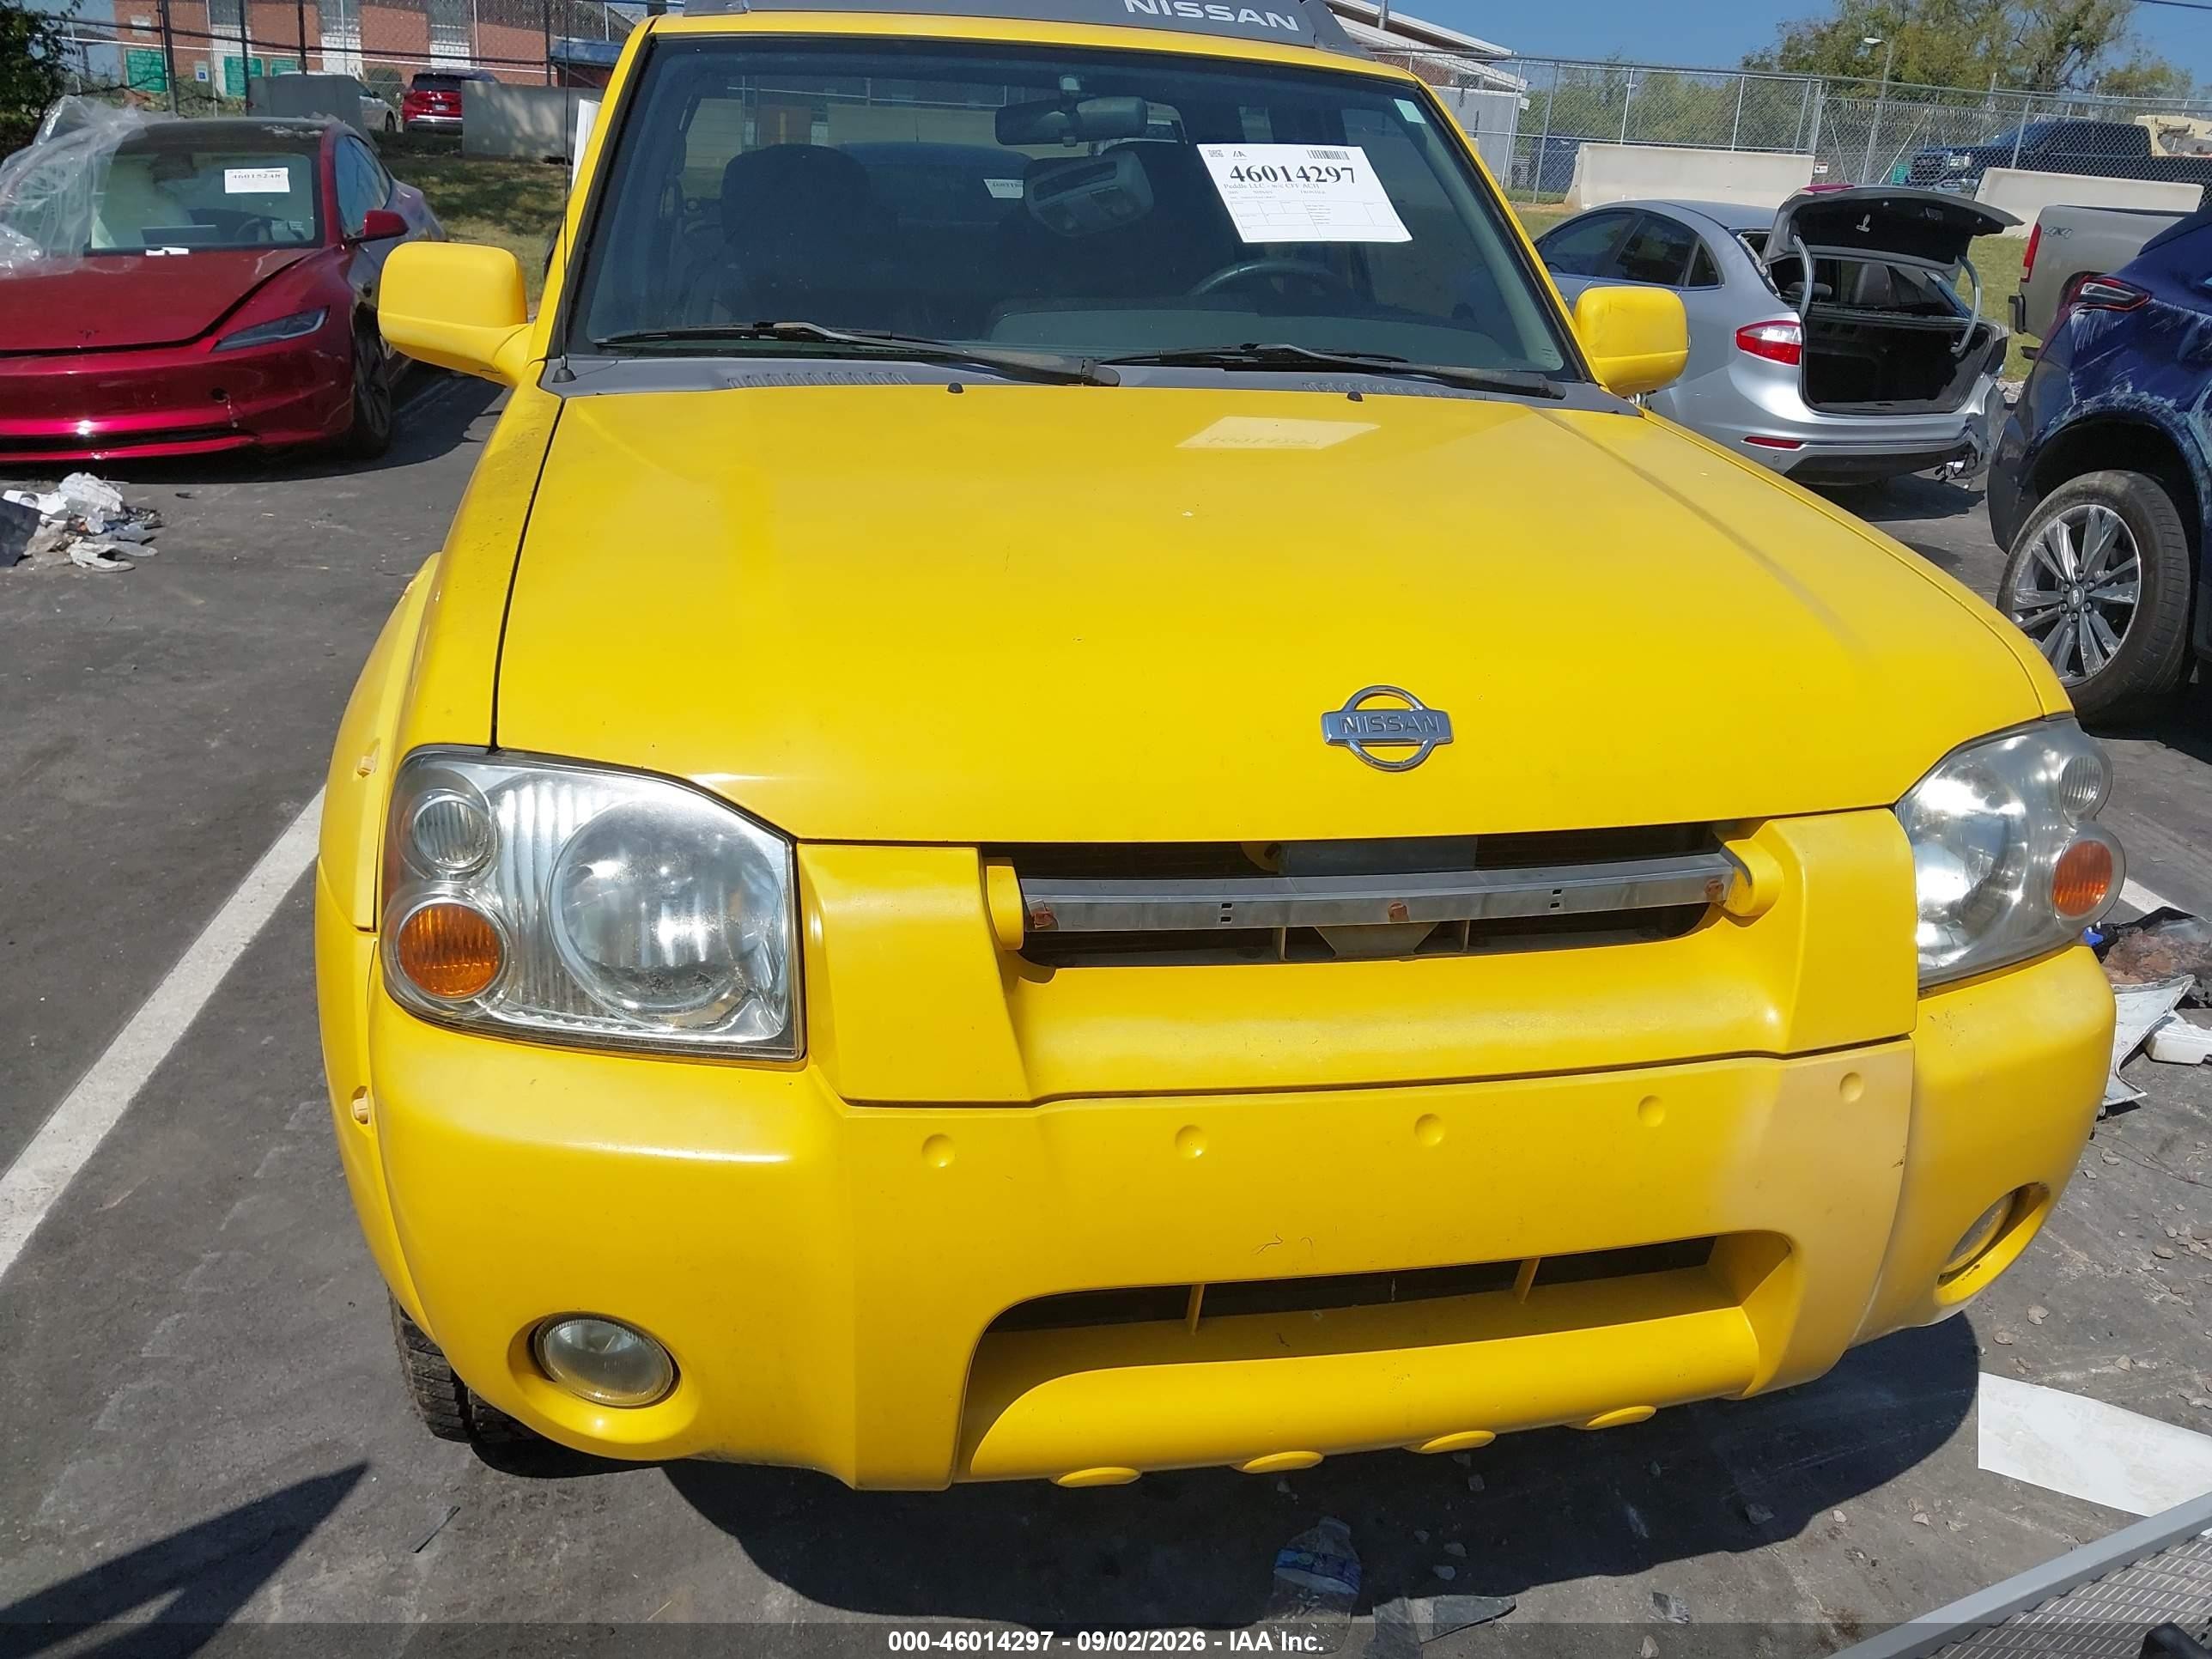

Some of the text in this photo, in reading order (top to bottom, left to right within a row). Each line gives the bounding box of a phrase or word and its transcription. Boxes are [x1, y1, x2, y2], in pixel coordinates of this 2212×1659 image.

[1124, 0, 1299, 31] NISSAN
[1230, 165, 1355, 184] 46014297
[1340, 714, 1441, 734] NISSAN
